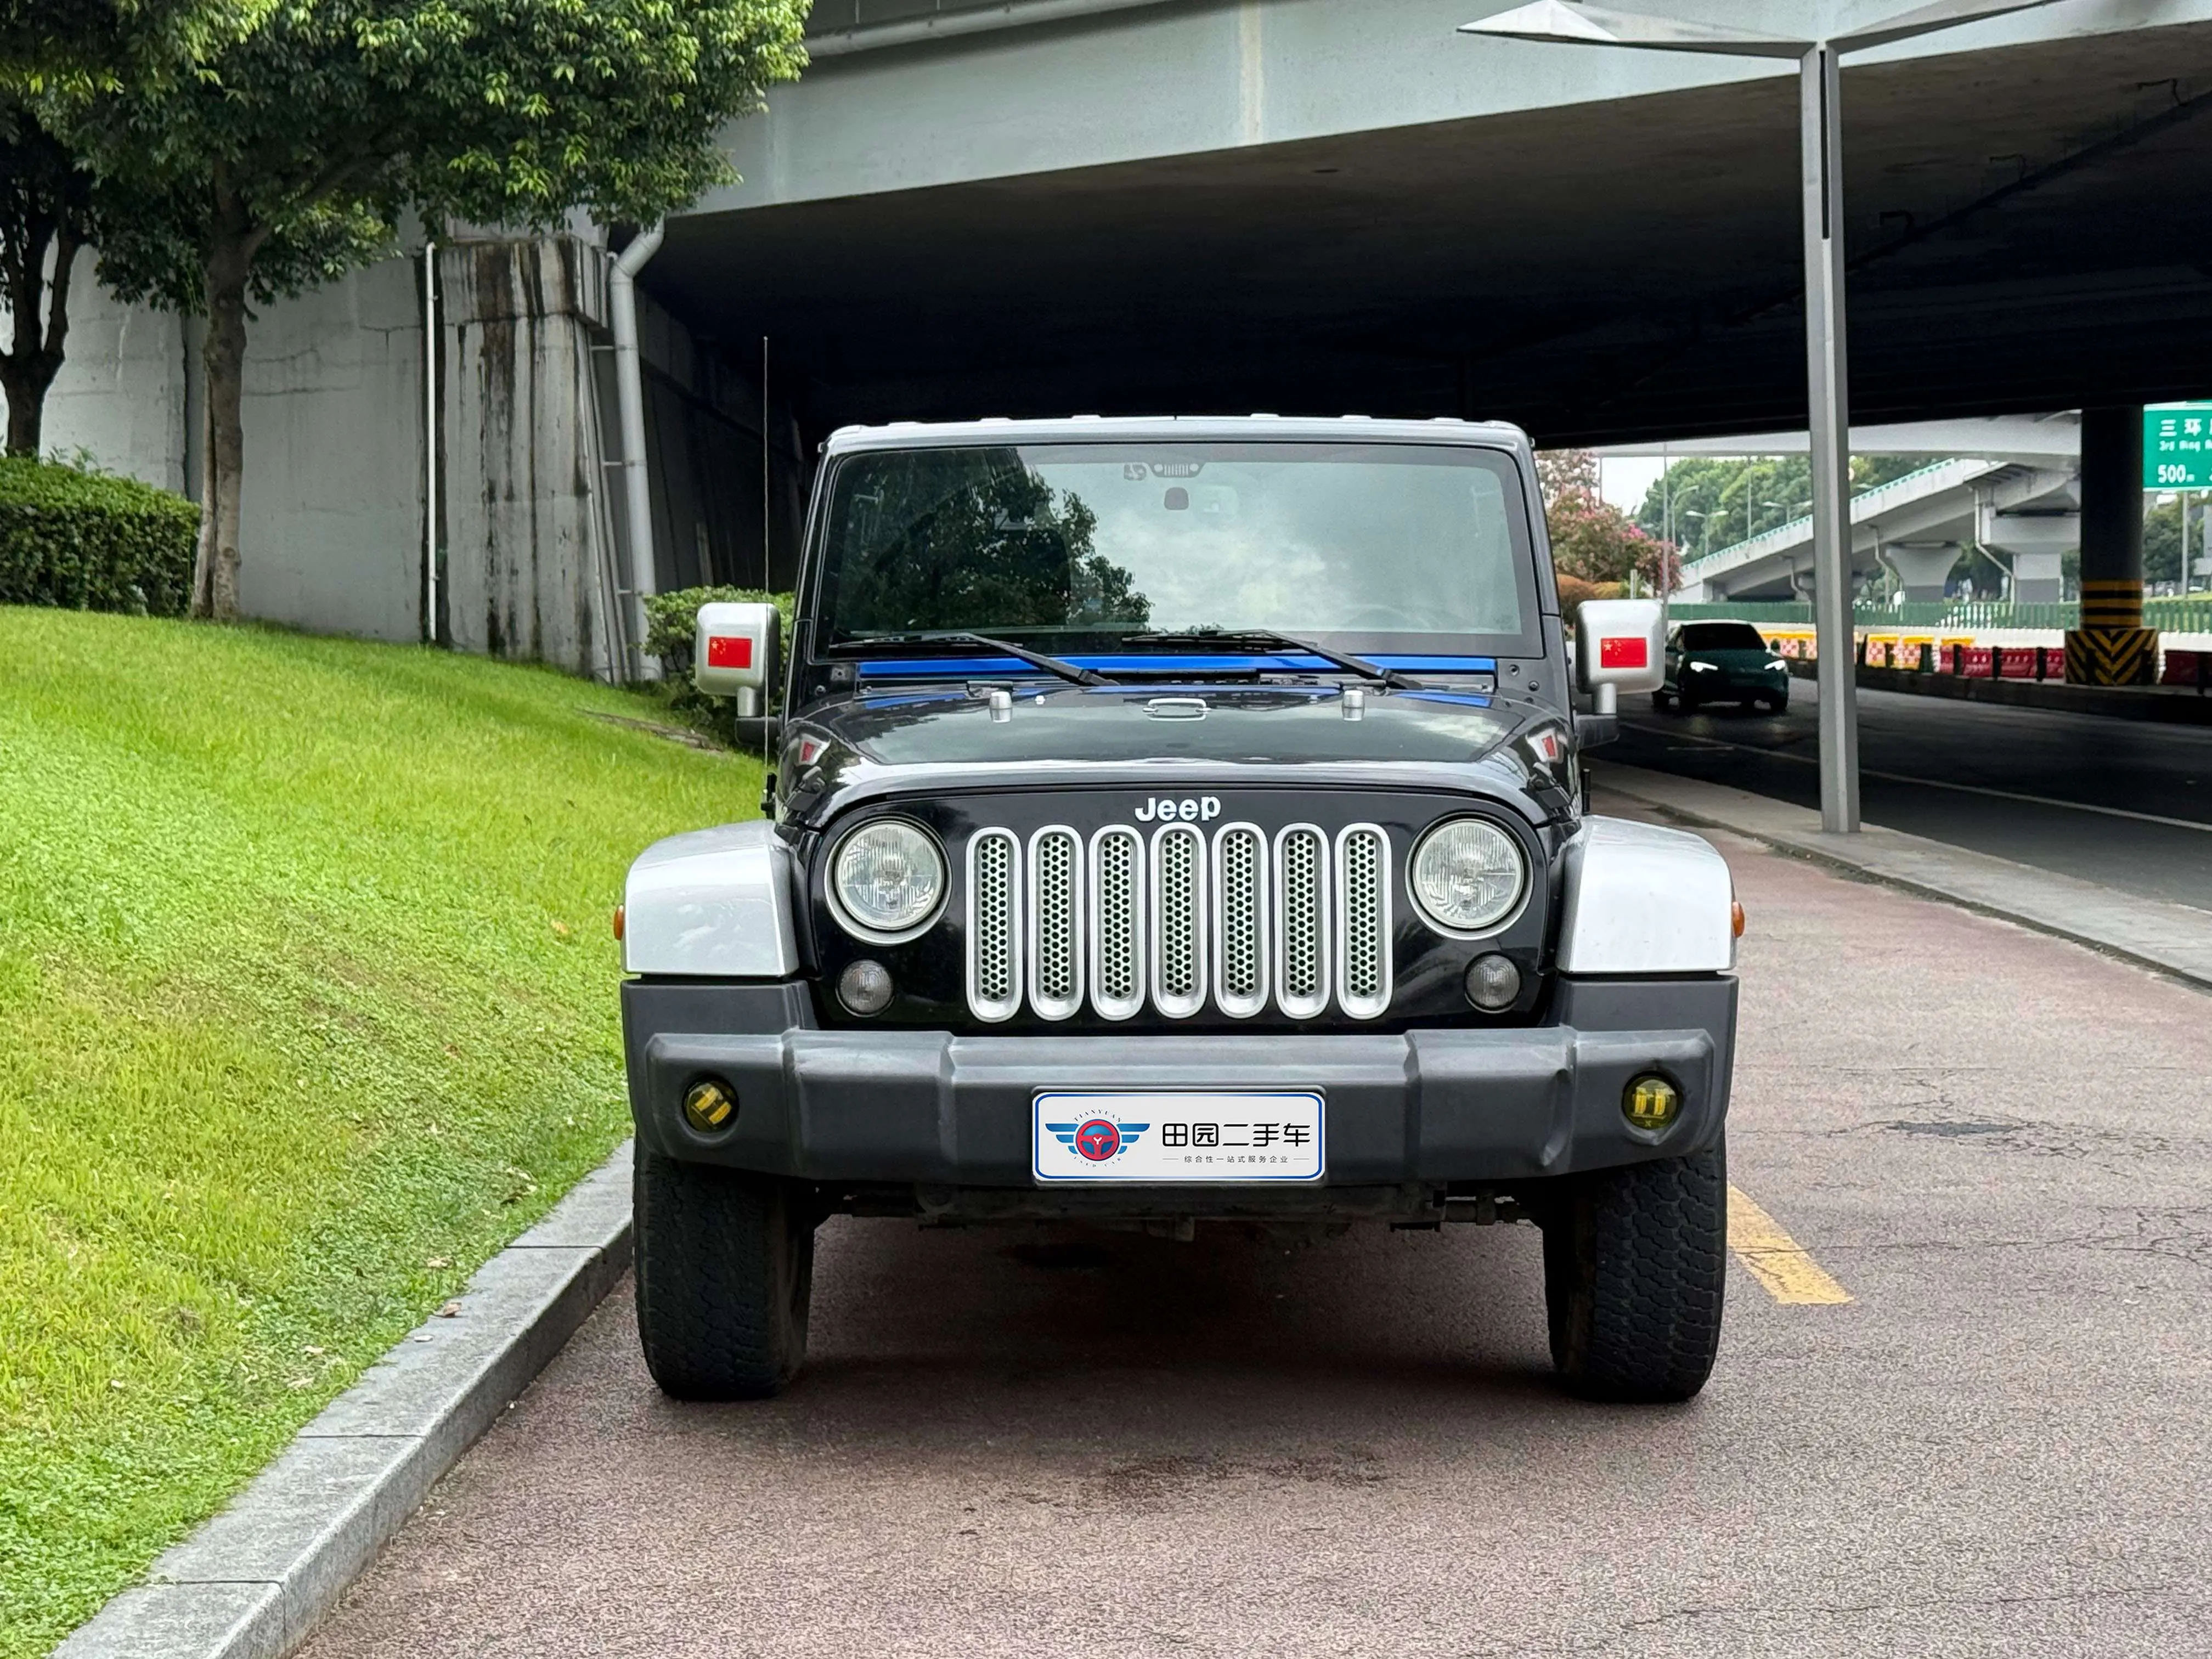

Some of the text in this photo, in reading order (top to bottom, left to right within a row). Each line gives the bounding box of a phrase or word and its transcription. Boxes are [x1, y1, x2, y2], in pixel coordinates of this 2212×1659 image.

[2159, 418, 2212, 437] 三环
[1135, 796, 1221, 821] Jeep
[1163, 1123, 1311, 1147] 田园二手车
[1184, 1155, 1289, 1164] 综合性一站式服务企业
